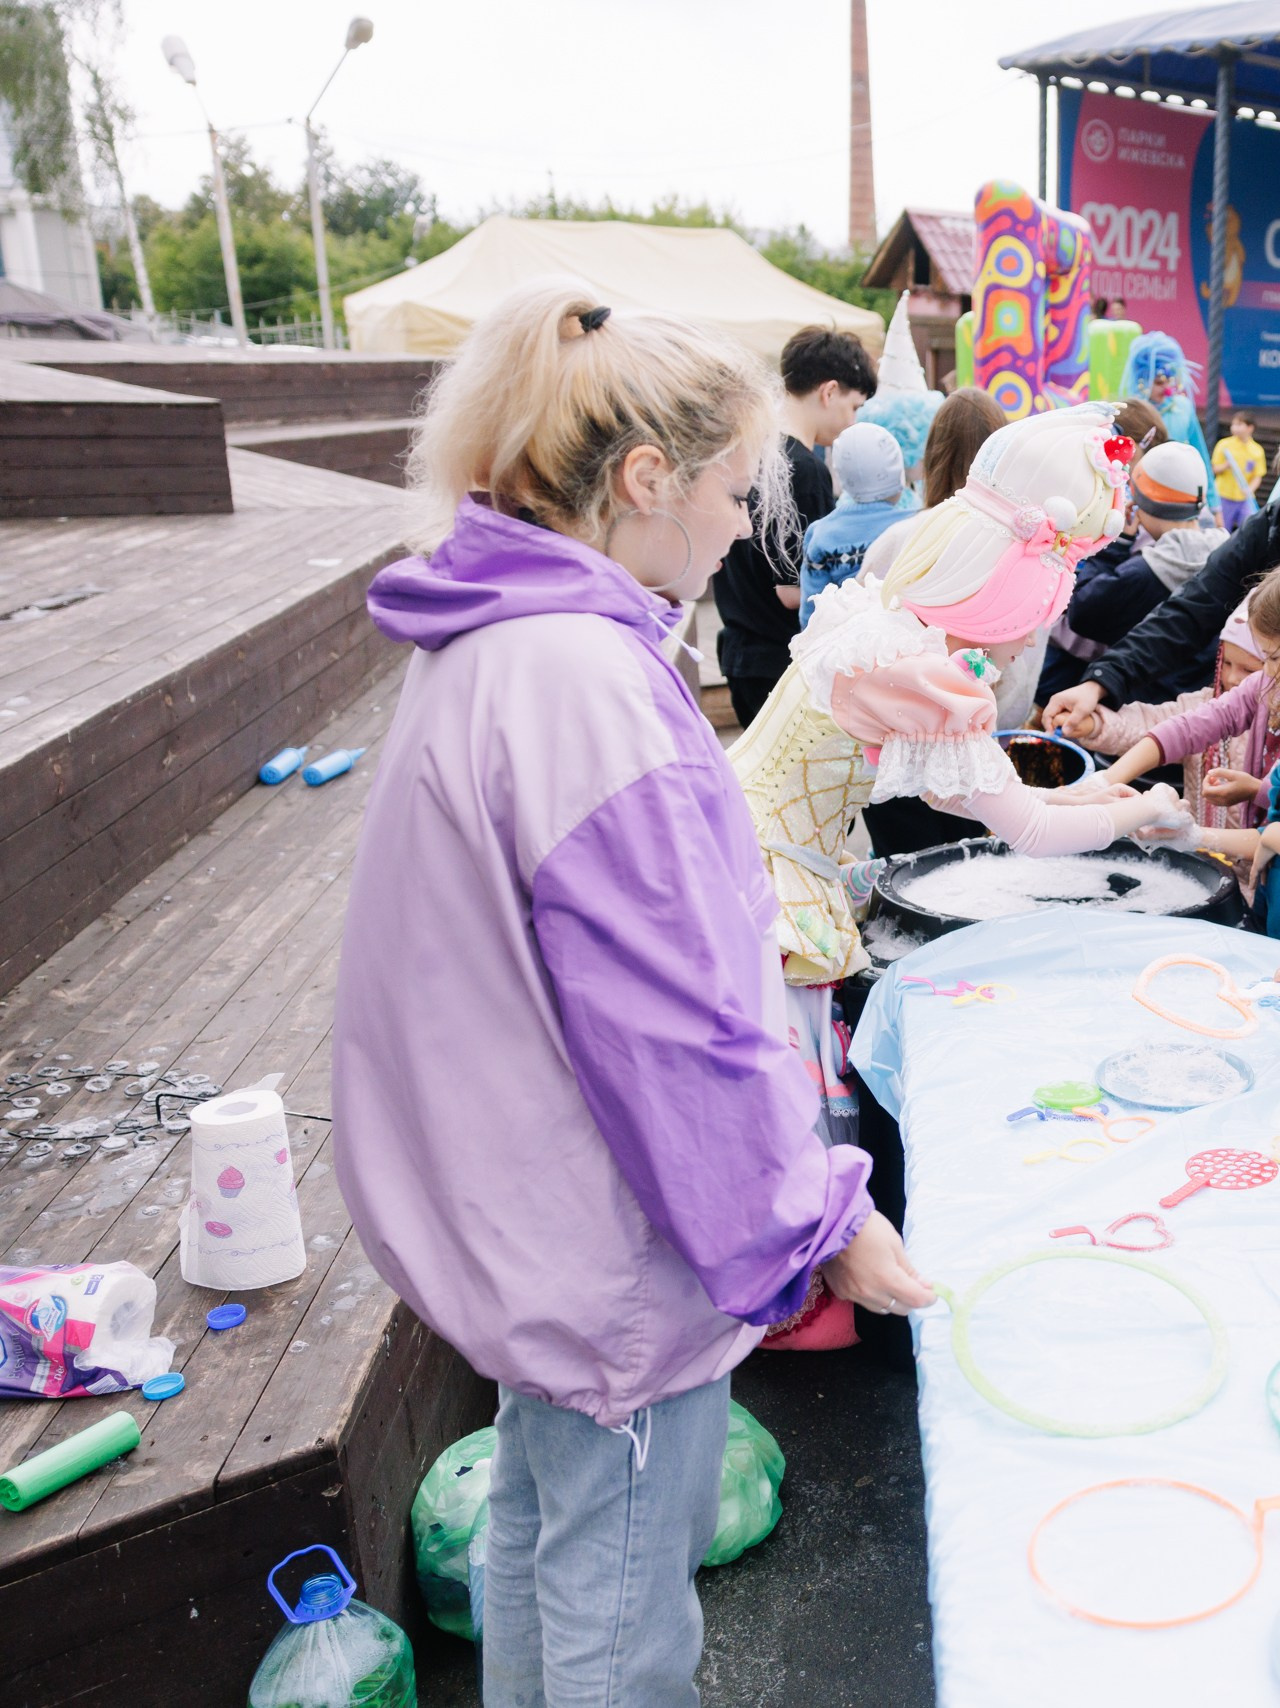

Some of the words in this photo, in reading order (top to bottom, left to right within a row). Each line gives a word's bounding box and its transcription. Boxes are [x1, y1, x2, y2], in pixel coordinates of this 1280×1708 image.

[1117, 127, 1166, 147] ПАРКИ
[1117, 148, 1185, 168] ИЖЕВСКА
[1094, 203, 1180, 272] 2024
[1092, 270, 1122, 298] ГОД
[1124, 272, 1177, 301] СЕМЬИ
